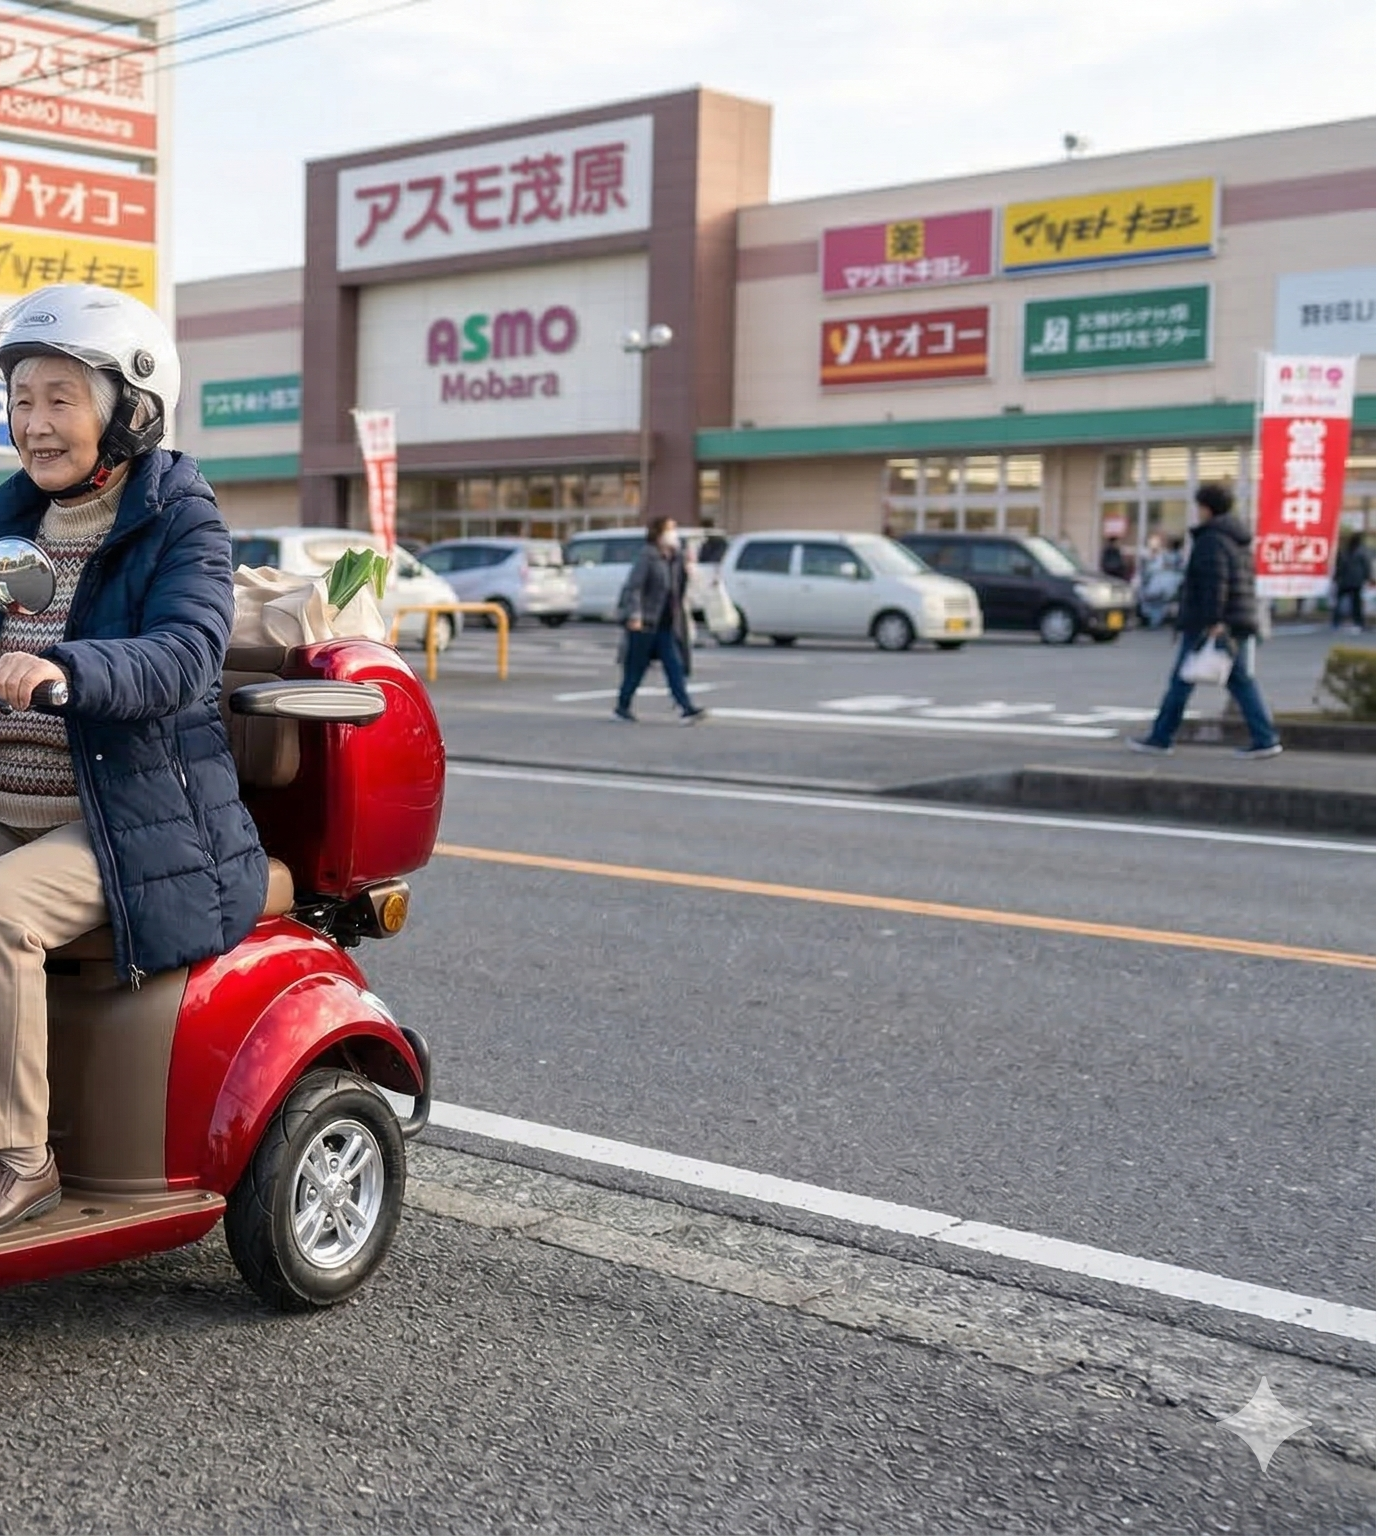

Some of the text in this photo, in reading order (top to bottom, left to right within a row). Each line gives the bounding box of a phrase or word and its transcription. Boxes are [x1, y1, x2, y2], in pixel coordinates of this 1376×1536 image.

[25, 174, 146, 226] ヤオコー
[354, 141, 628, 249] アスモ茂原
[427, 305, 578, 366] ASMO
[859, 321, 985, 360] ヤオコー
[441, 370, 560, 402] Mobara
[1282, 419, 1327, 531] 営業中
